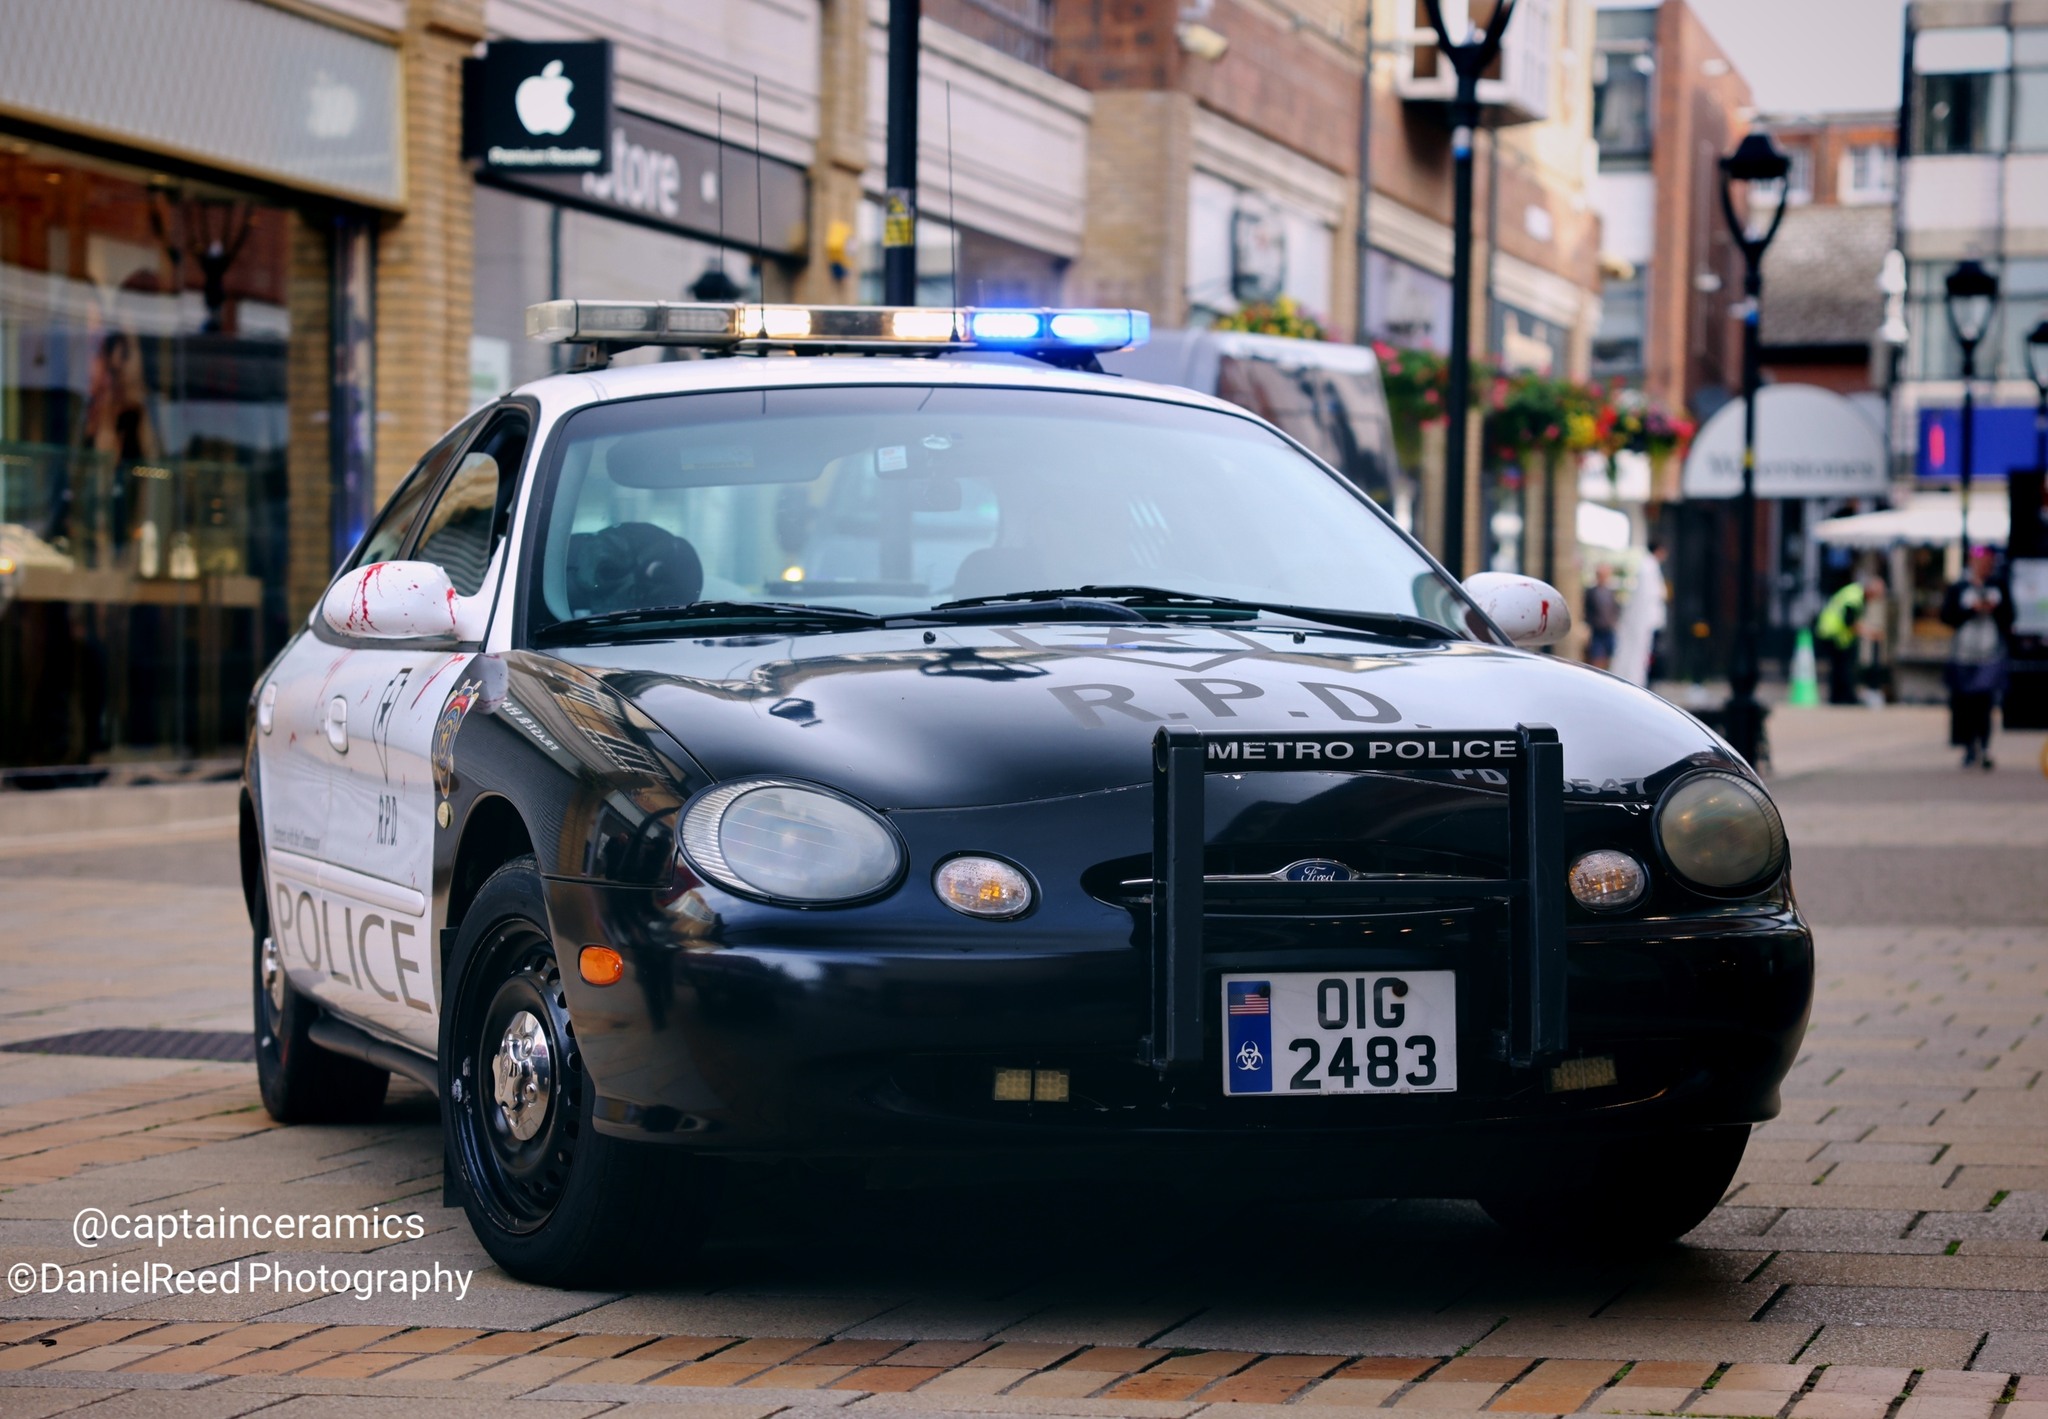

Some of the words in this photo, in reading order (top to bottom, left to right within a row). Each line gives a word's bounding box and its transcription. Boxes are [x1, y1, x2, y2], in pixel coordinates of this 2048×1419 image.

[1047, 679, 1432, 729] R.P.D.
[1208, 741, 1354, 760] METRO
[1369, 740, 1518, 760] POLICE
[276, 883, 433, 1015] POLICE
[1288, 1035, 1437, 1090] 2483
